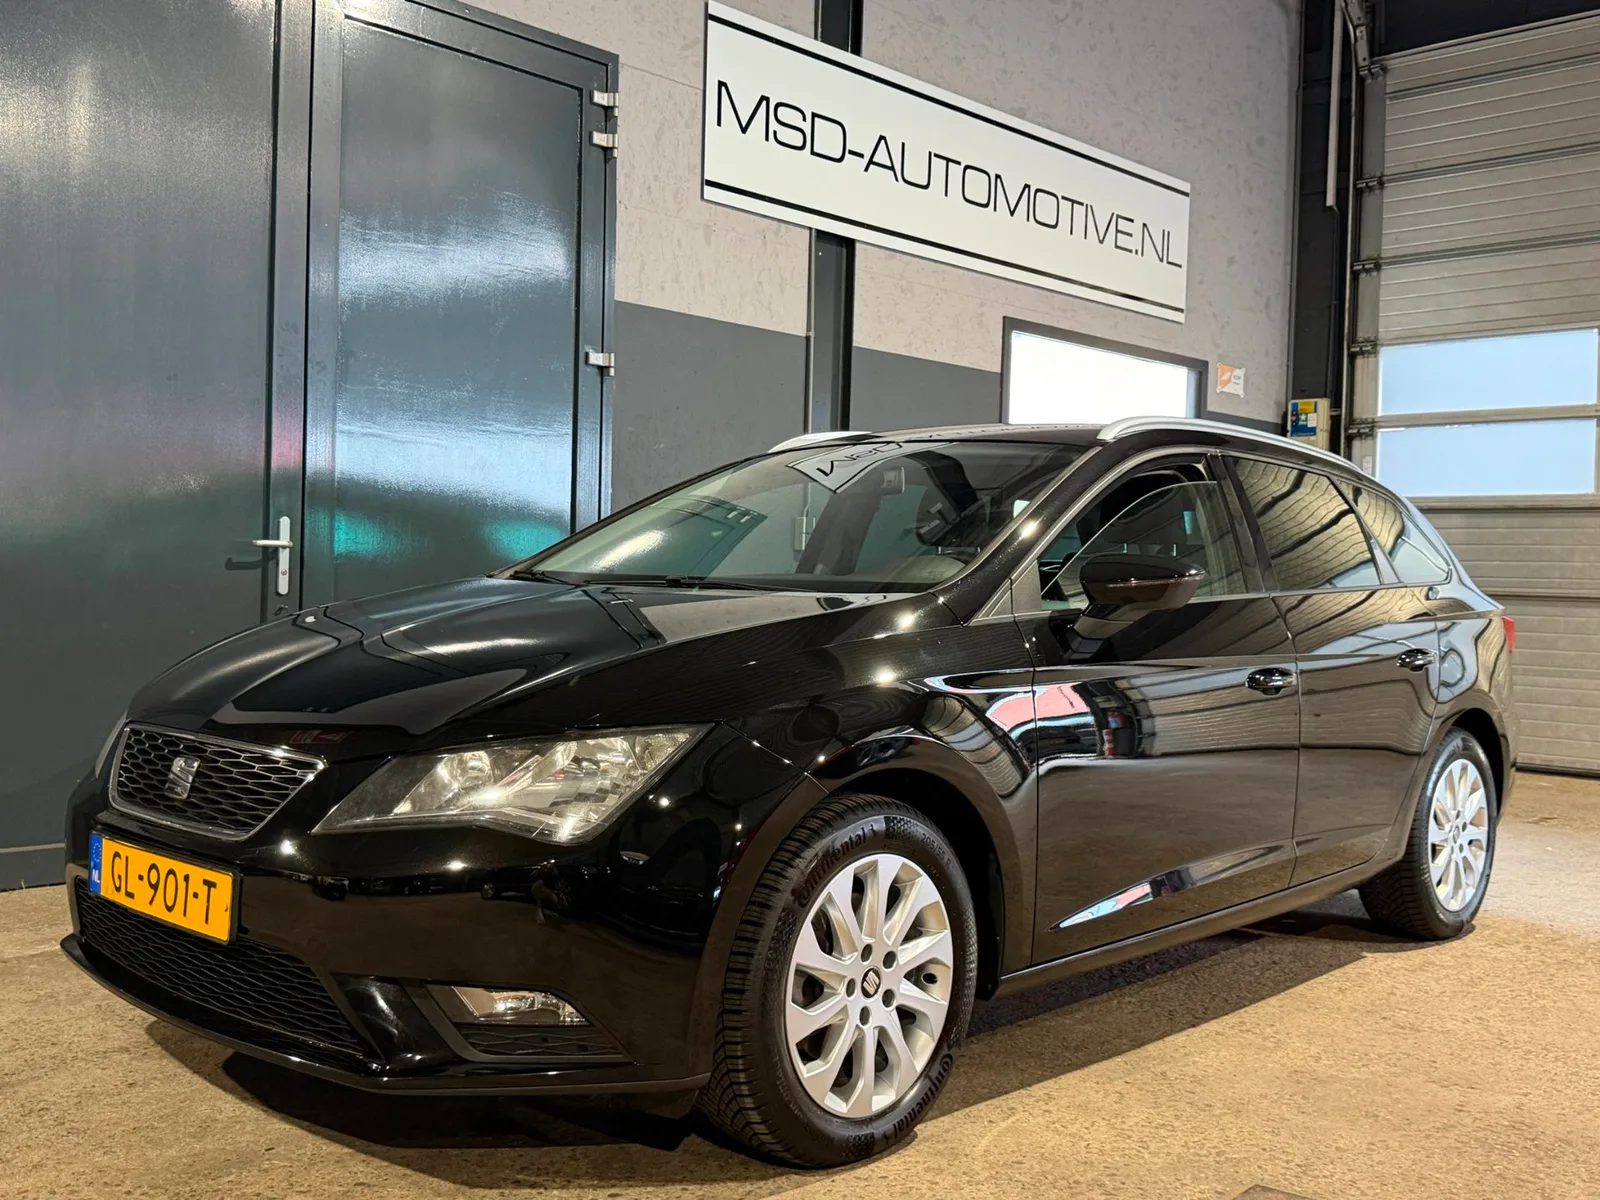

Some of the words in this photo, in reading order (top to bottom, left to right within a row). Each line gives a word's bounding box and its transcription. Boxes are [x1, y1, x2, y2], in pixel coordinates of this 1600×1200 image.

[716, 79, 1183, 269] MSD-AUTOMOTIVE.NL
[91, 868, 101, 884] NL
[111, 850, 217, 925] GL-901-T
